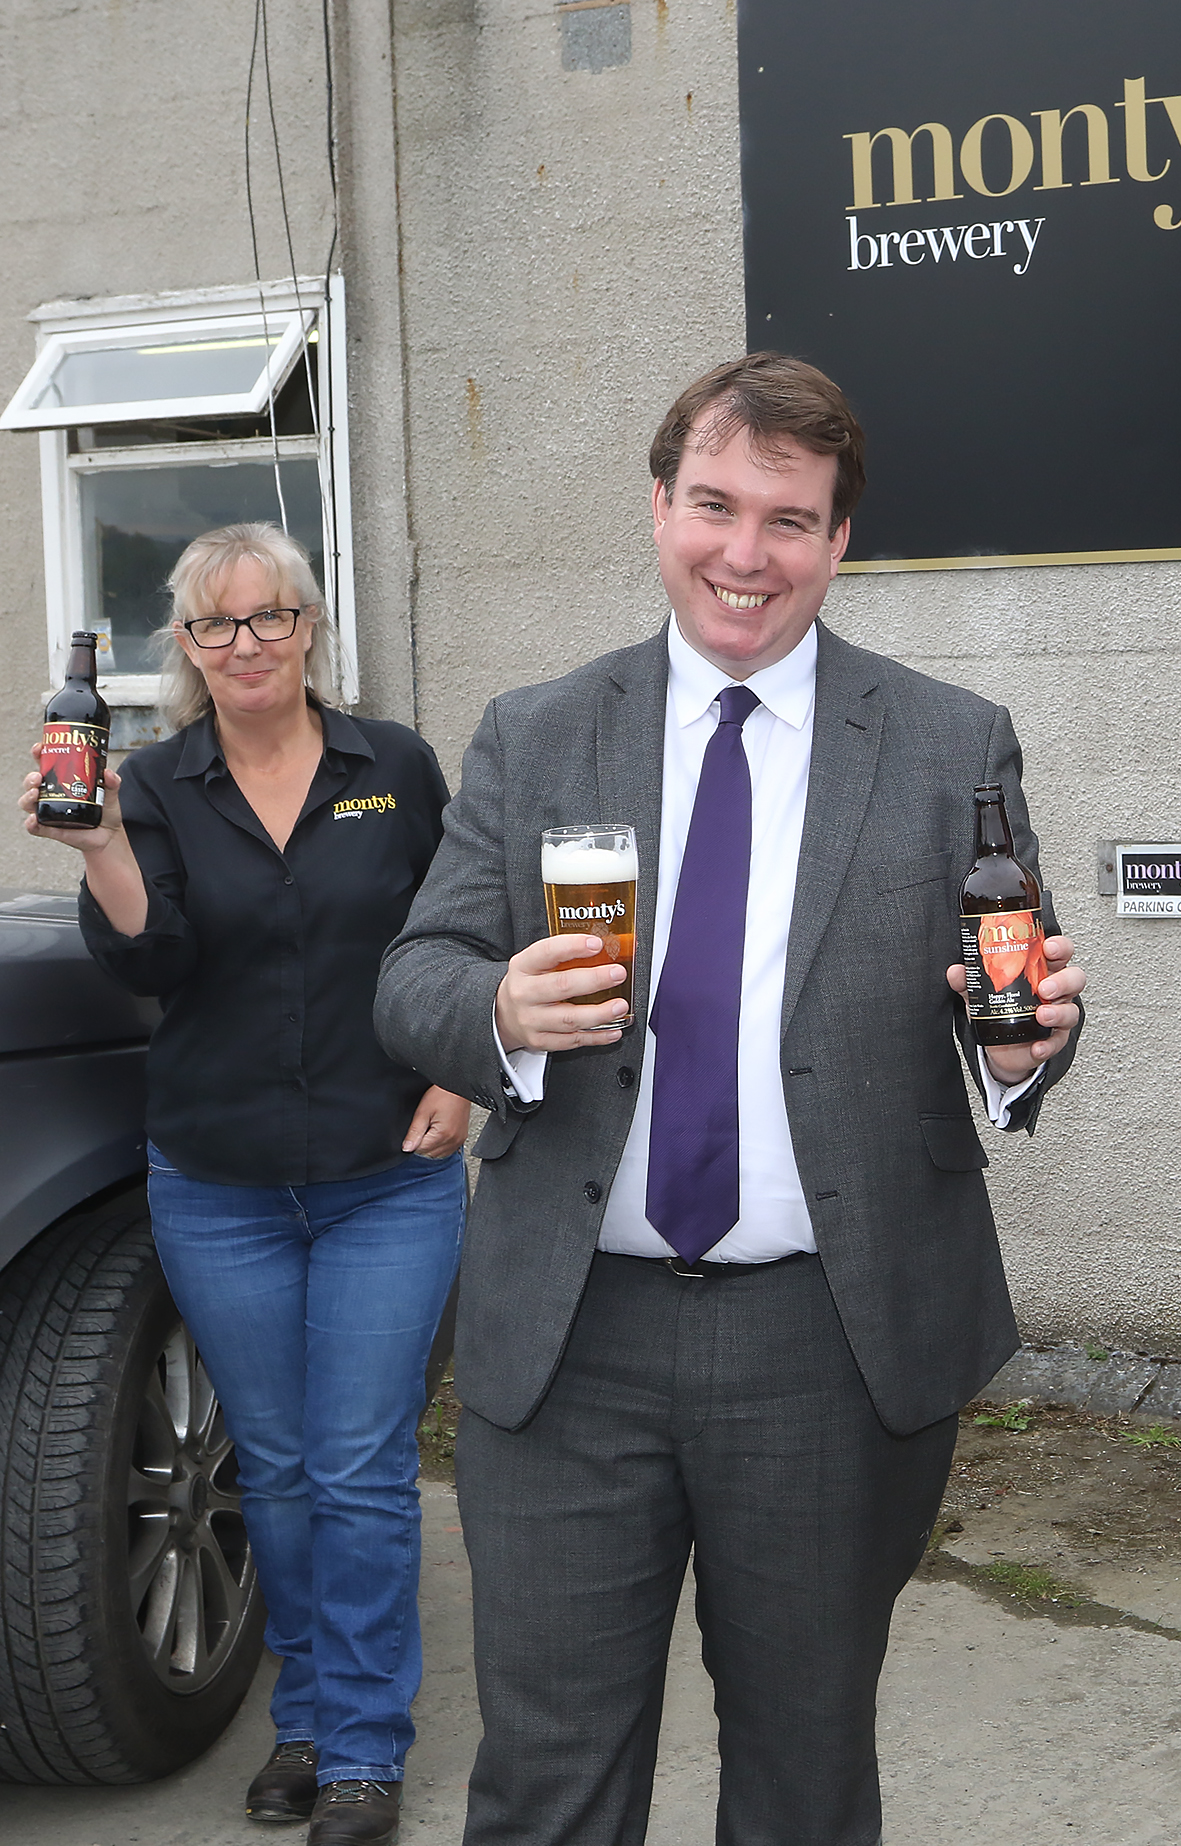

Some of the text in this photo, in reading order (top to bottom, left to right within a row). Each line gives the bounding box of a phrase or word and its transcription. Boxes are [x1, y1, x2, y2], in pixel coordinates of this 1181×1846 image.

[845, 215, 1046, 275] brewery
[333, 793, 396, 814] monty's
[1126, 879, 1162, 893] brewery
[558, 899, 626, 924] monty's
[1123, 901, 1174, 913] PARKING
[983, 940, 1029, 955] sunshine
